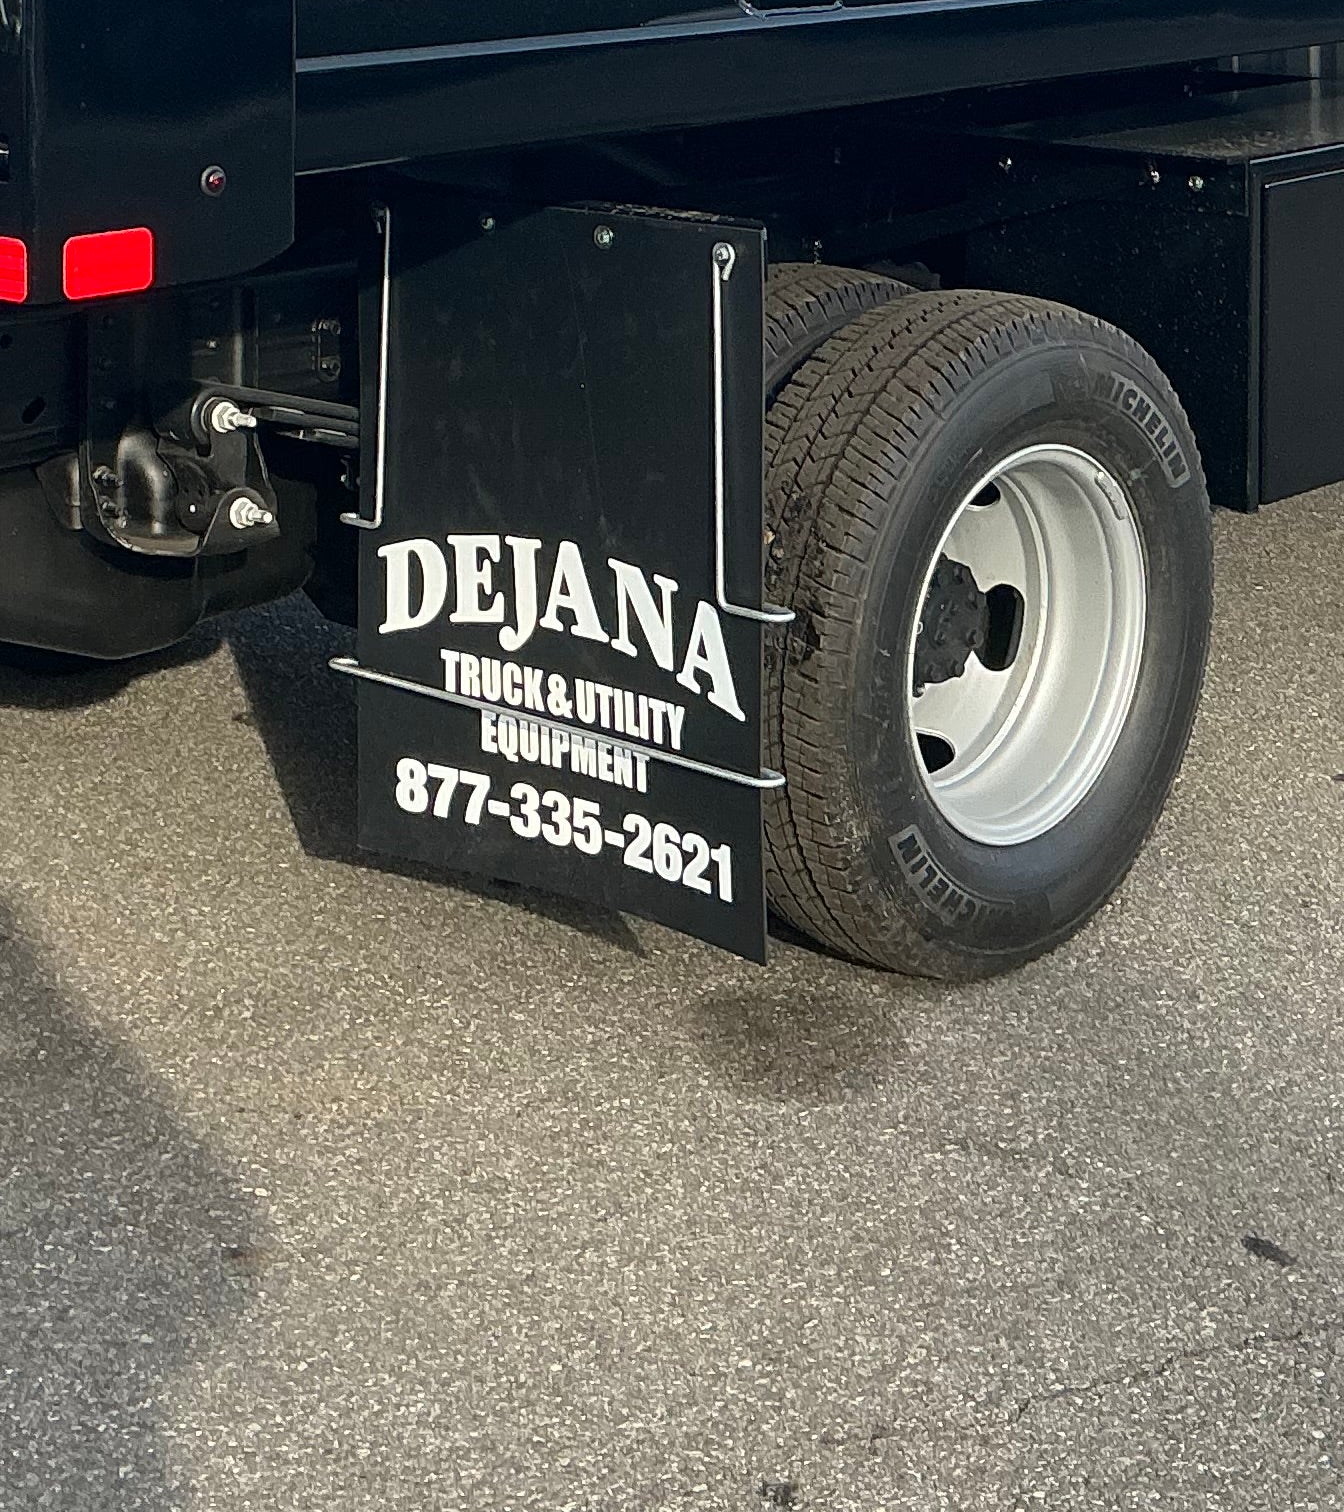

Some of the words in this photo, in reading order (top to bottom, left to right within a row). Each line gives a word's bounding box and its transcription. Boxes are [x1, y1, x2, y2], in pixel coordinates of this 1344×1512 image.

[1092, 372, 1187, 480] MICHELIN
[376, 533, 747, 723] DEJANA
[480, 708, 651, 794] EQUIPMENT
[394, 756, 734, 904] 877-335-2621
[896, 832, 1003, 925] ICHELIN
